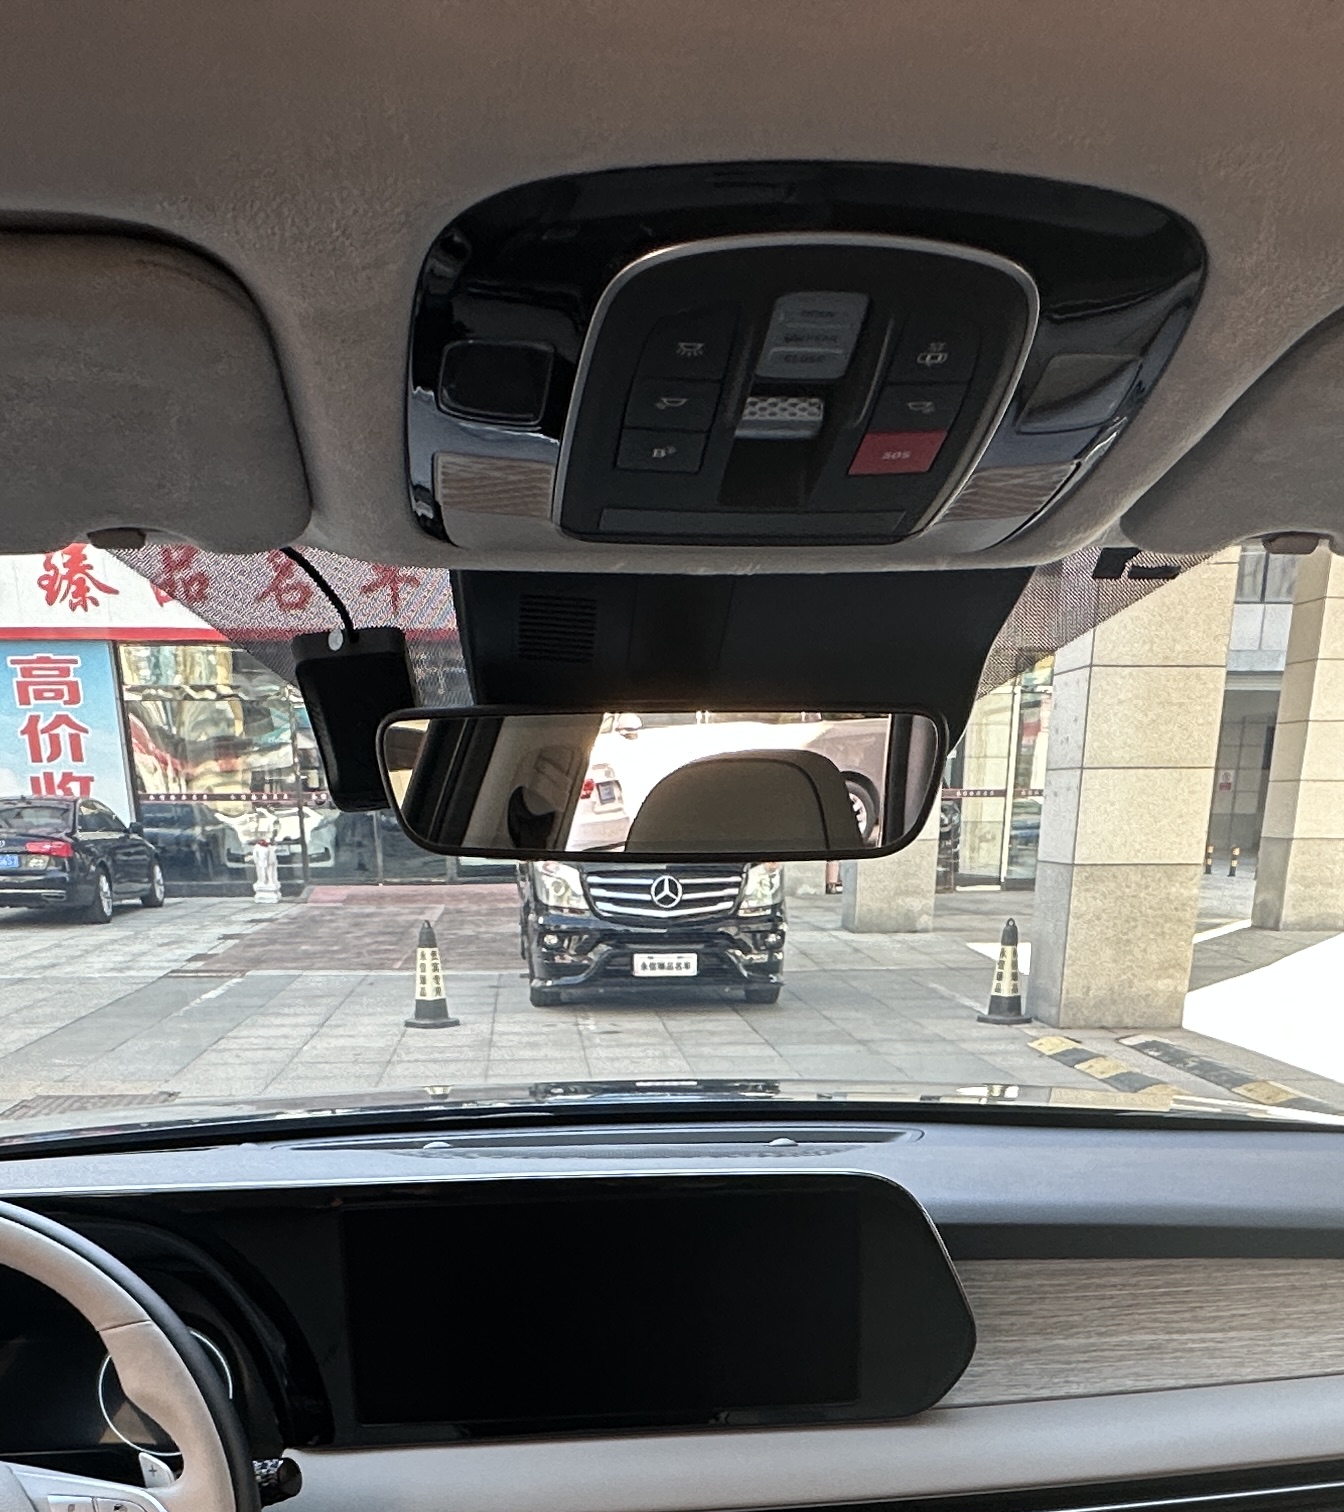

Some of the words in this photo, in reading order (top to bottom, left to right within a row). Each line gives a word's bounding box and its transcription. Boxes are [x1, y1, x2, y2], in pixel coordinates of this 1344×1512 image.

[882, 450, 912, 460] SOS
[8, 655, 95, 797] 高价收
